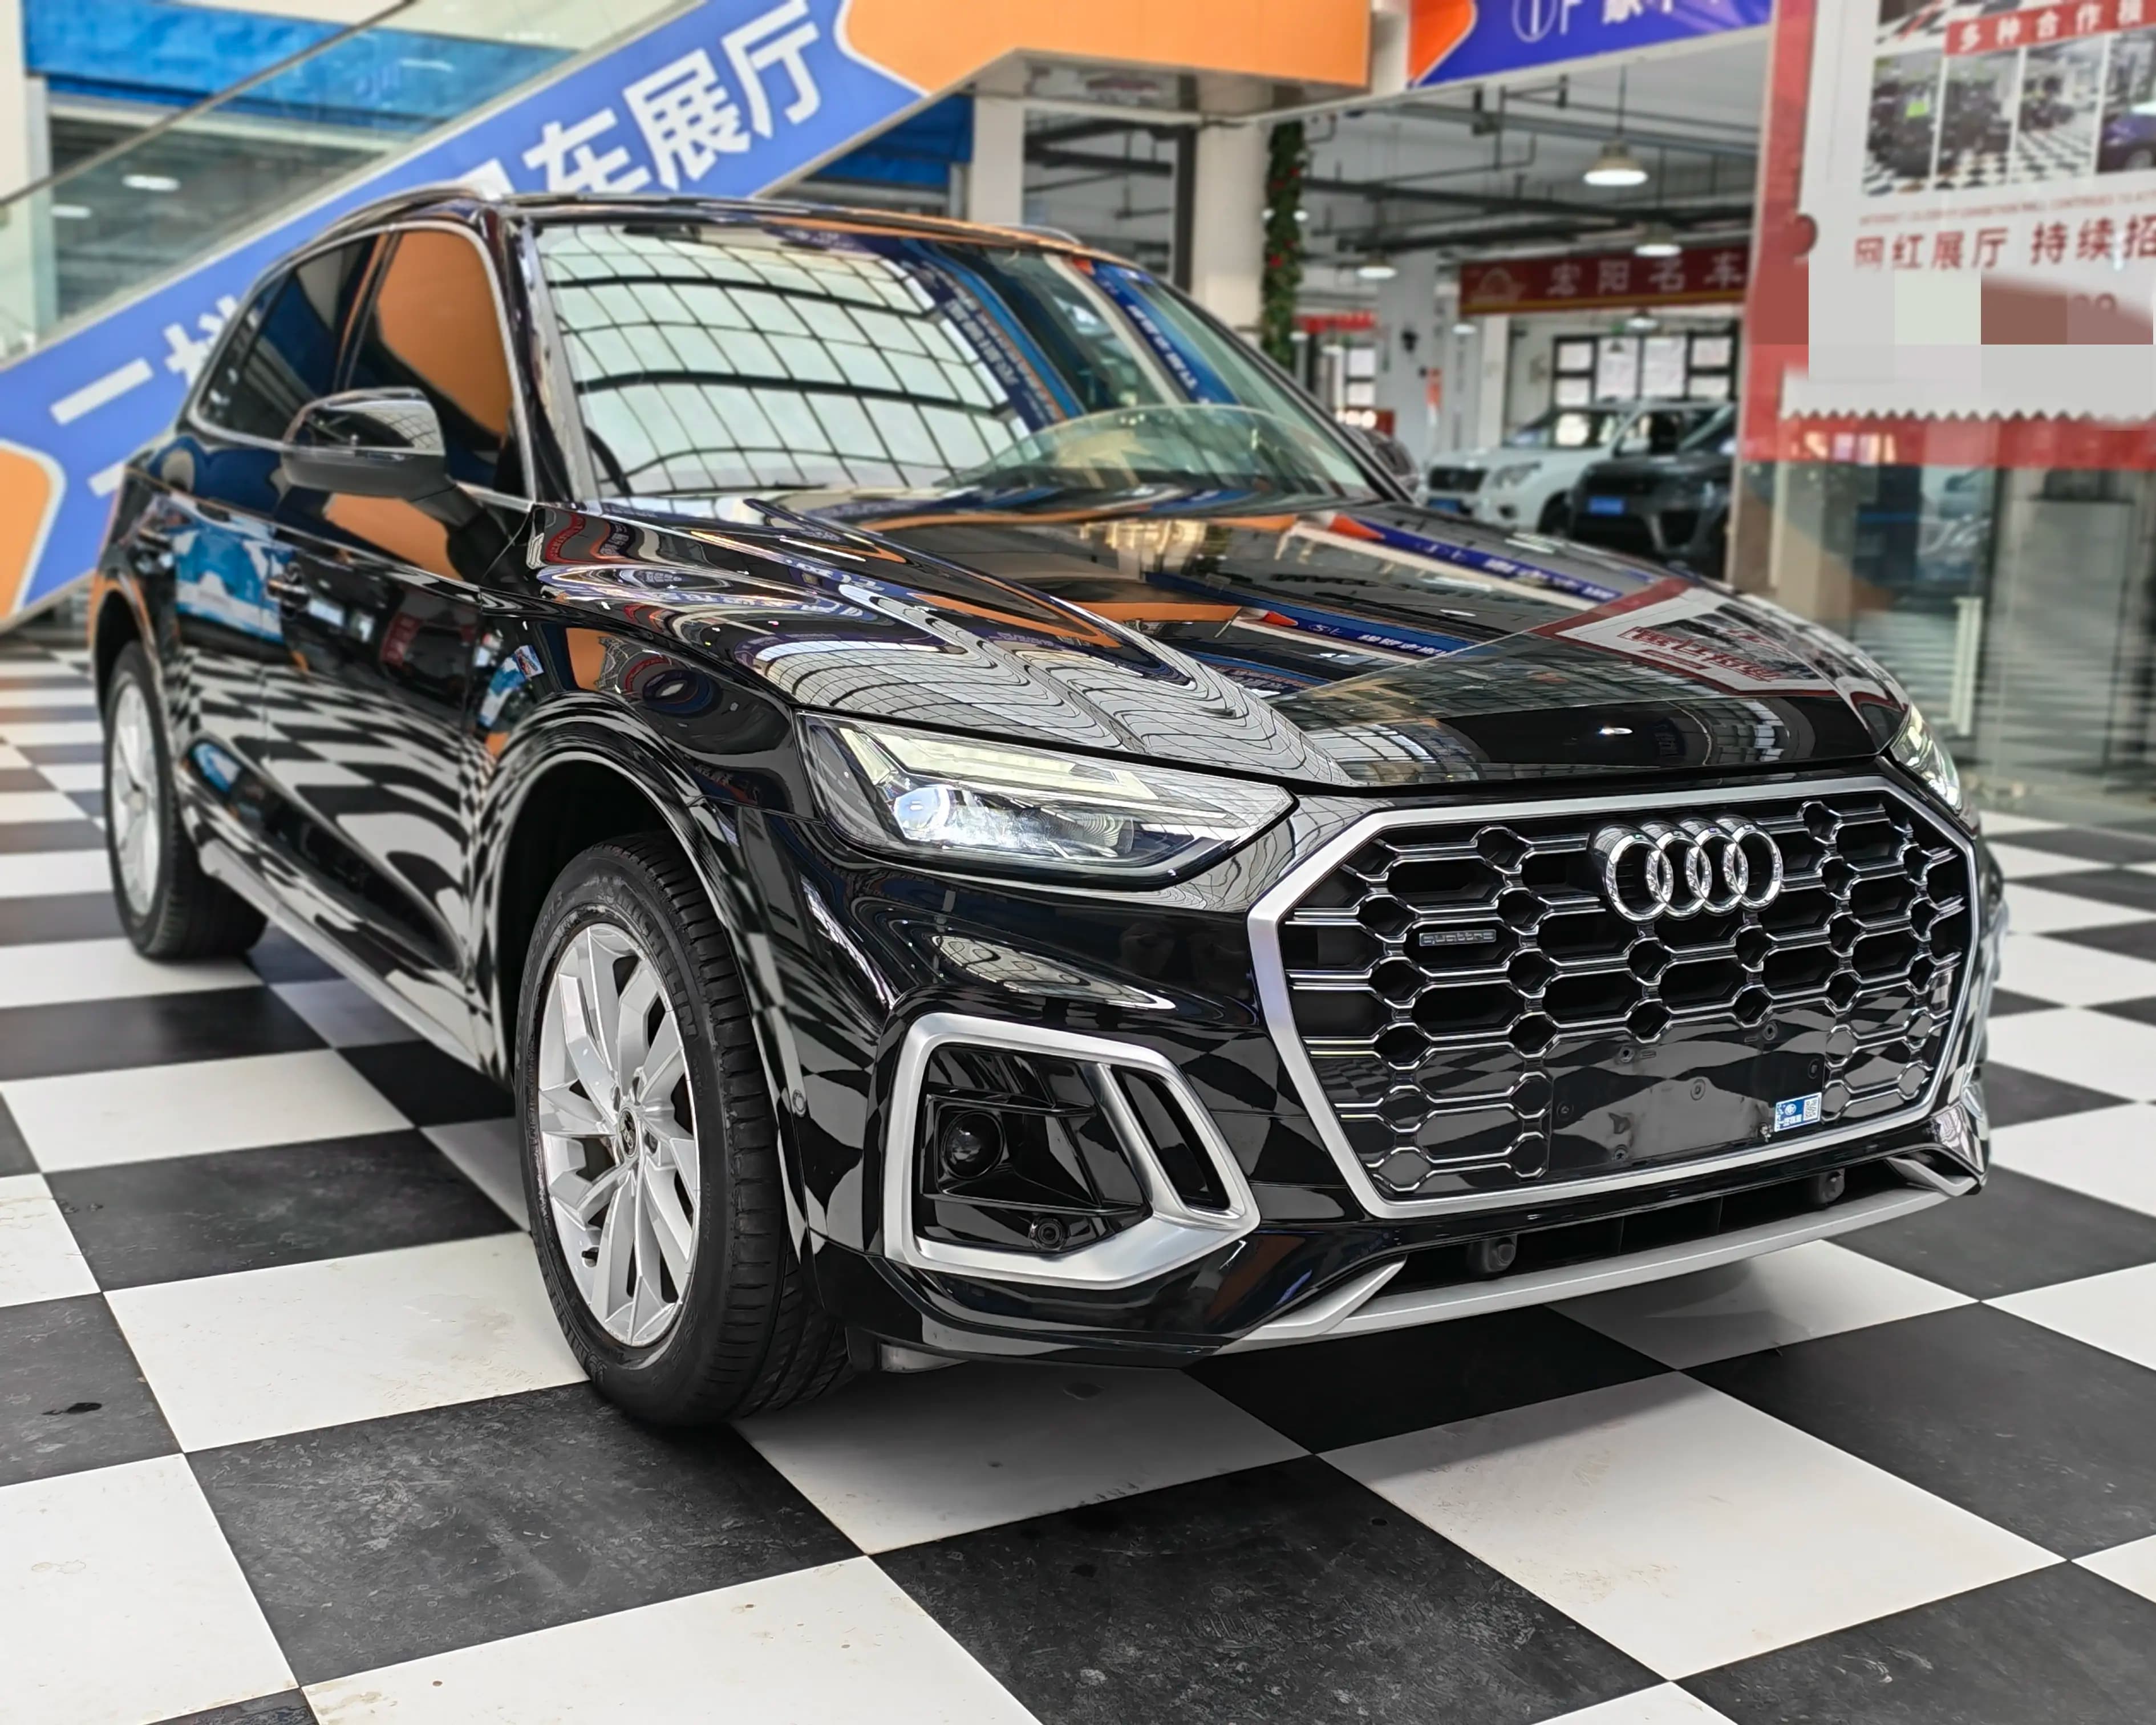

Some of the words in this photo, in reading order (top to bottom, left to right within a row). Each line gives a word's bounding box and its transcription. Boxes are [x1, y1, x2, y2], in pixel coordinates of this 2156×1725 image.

[456, 0, 820, 200] 车展厅
[1854, 226, 2008, 269] 网红展厅
[617, 893, 698, 1035] MICHELIN
[1424, 931, 1494, 945] quattro
